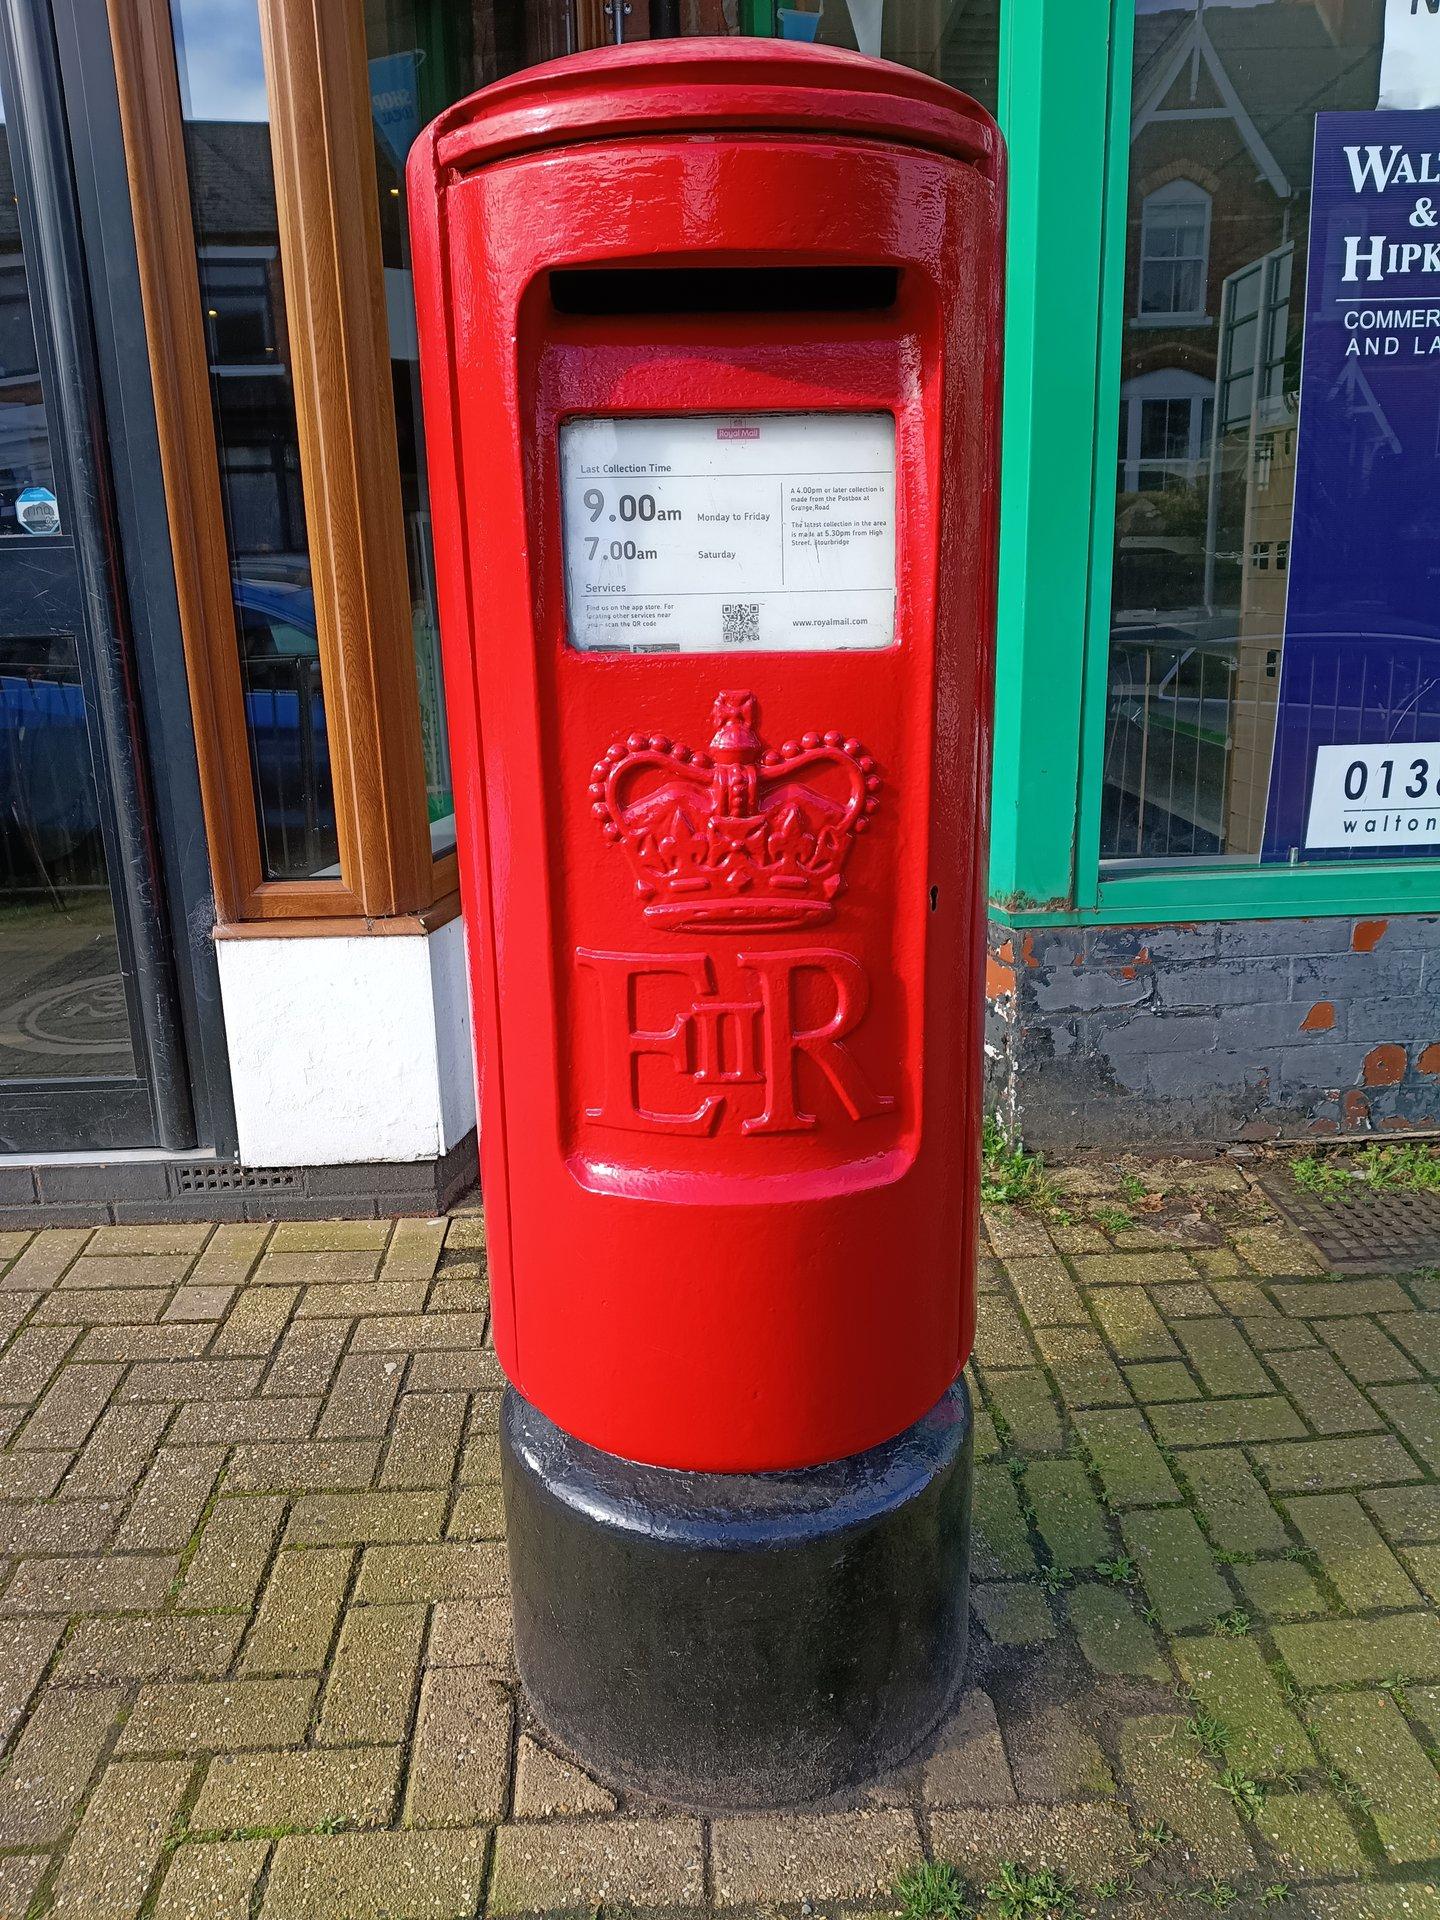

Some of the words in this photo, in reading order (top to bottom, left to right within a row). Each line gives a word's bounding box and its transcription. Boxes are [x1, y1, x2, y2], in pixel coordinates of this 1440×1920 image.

[1343, 145, 1440, 193] WAL
[1408, 197, 1438, 227] &
[1341, 235, 1440, 281] HIPK
[1344, 309, 1440, 330] COMMER
[1345, 336, 1400, 356] AND
[718, 429, 740, 439] Royal
[741, 428, 758, 437] Mail
[580, 464, 600, 474] Last
[602, 464, 647, 473] Collection
[648, 463, 672, 472] Time
[797, 486, 823, 494] 4.00pm
[583, 488, 682, 523] 9.00am
[697, 512, 731, 523] Monday
[732, 512, 742, 521] to
[744, 511, 771, 522] Friday
[868, 529, 883, 537] High
[584, 537, 658, 561] 7.00am
[697, 550, 737, 560] Saturday
[585, 583, 627, 593] Services
[631, 604, 644, 612] app
[792, 617, 869, 627] www.royalmail.com
[1344, 758, 1440, 800] 013
[1343, 814, 1437, 833] walton
